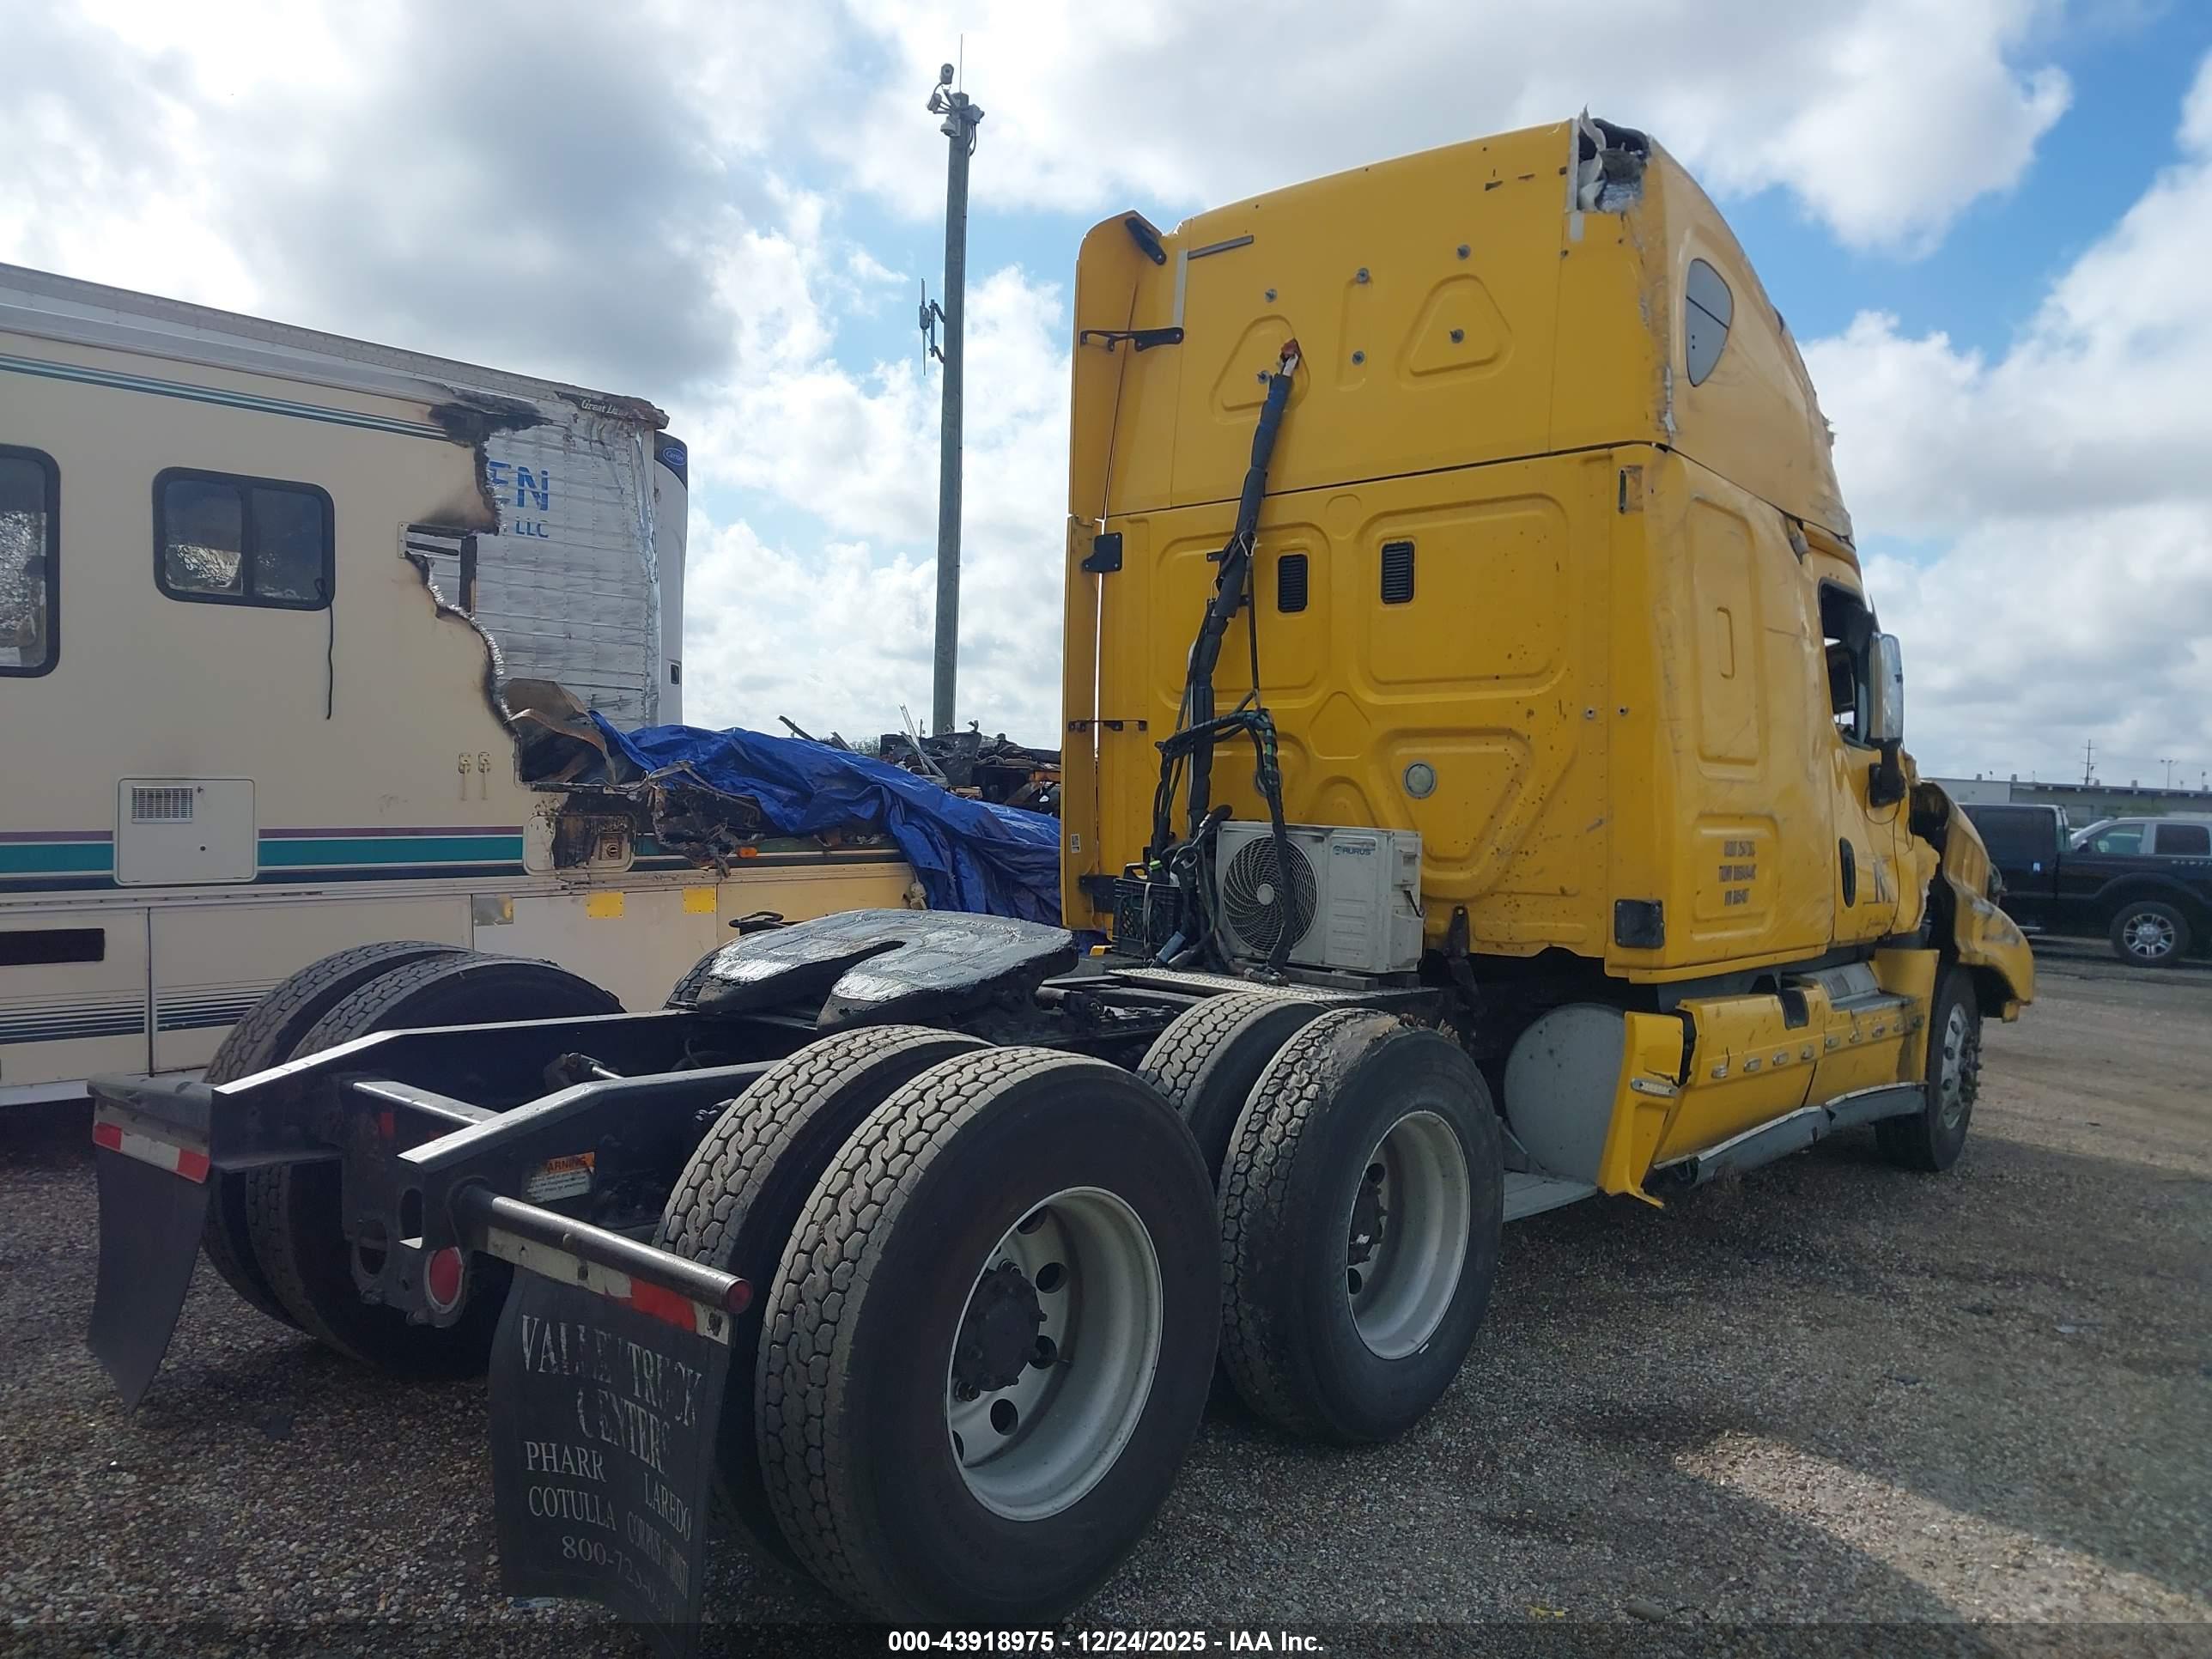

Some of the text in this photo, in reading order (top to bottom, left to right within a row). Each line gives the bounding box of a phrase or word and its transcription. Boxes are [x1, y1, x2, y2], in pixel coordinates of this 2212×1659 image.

[580, 399, 606, 413] Great
[515, 516, 550, 538] LLC
[543, 1156, 587, 1172] ARNING
[525, 1441, 607, 1483] PHARR
[529, 1486, 617, 1532] COTULLA
[644, 1472, 692, 1542] LAREDO
